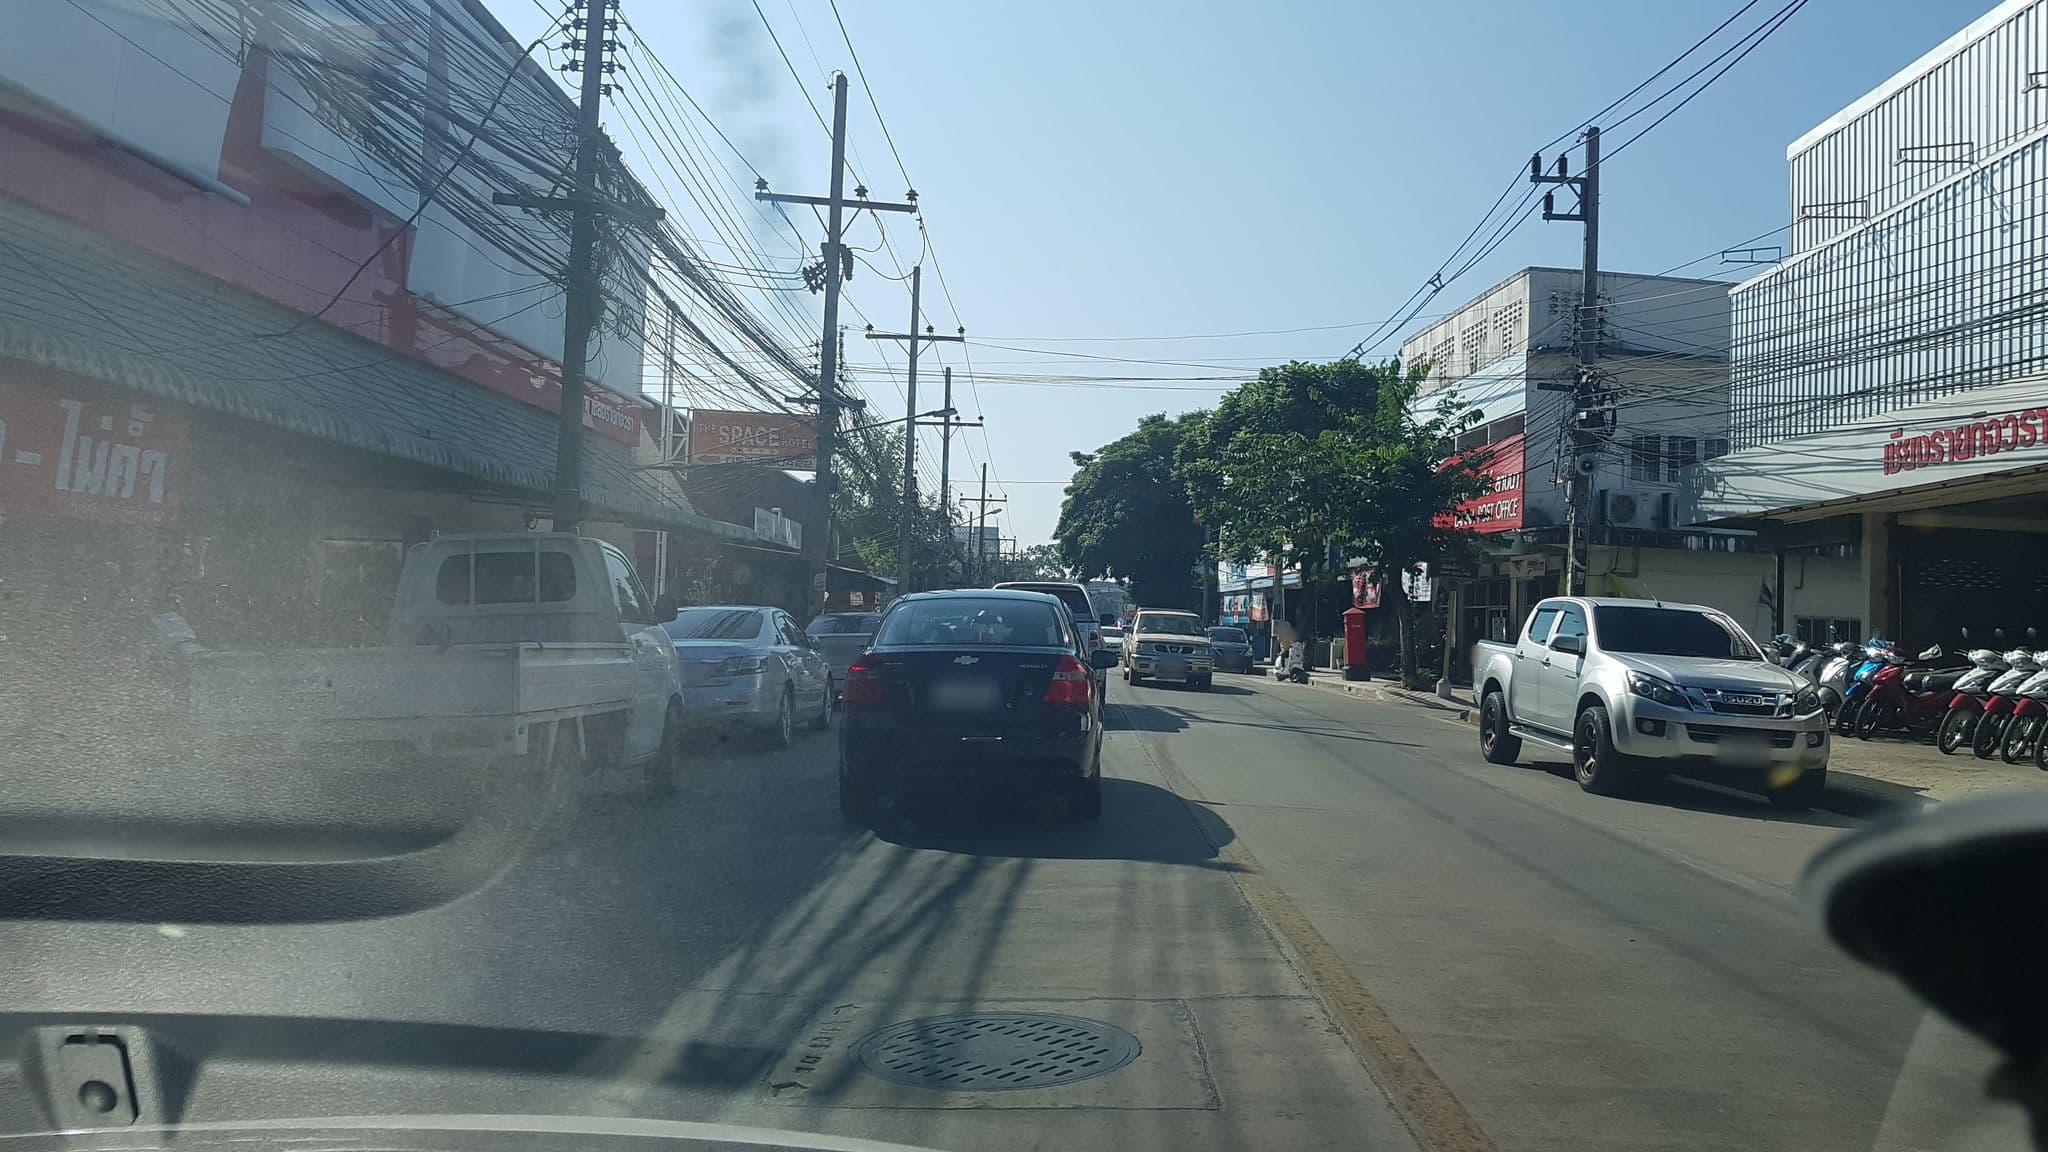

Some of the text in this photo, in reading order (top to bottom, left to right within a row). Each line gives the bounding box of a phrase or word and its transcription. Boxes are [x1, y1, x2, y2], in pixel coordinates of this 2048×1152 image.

[698, 423, 814, 449] THE SPACE HOTEL
[1495, 498, 1519, 520] OFFICE
[1724, 694, 1762, 705] ISUZU
